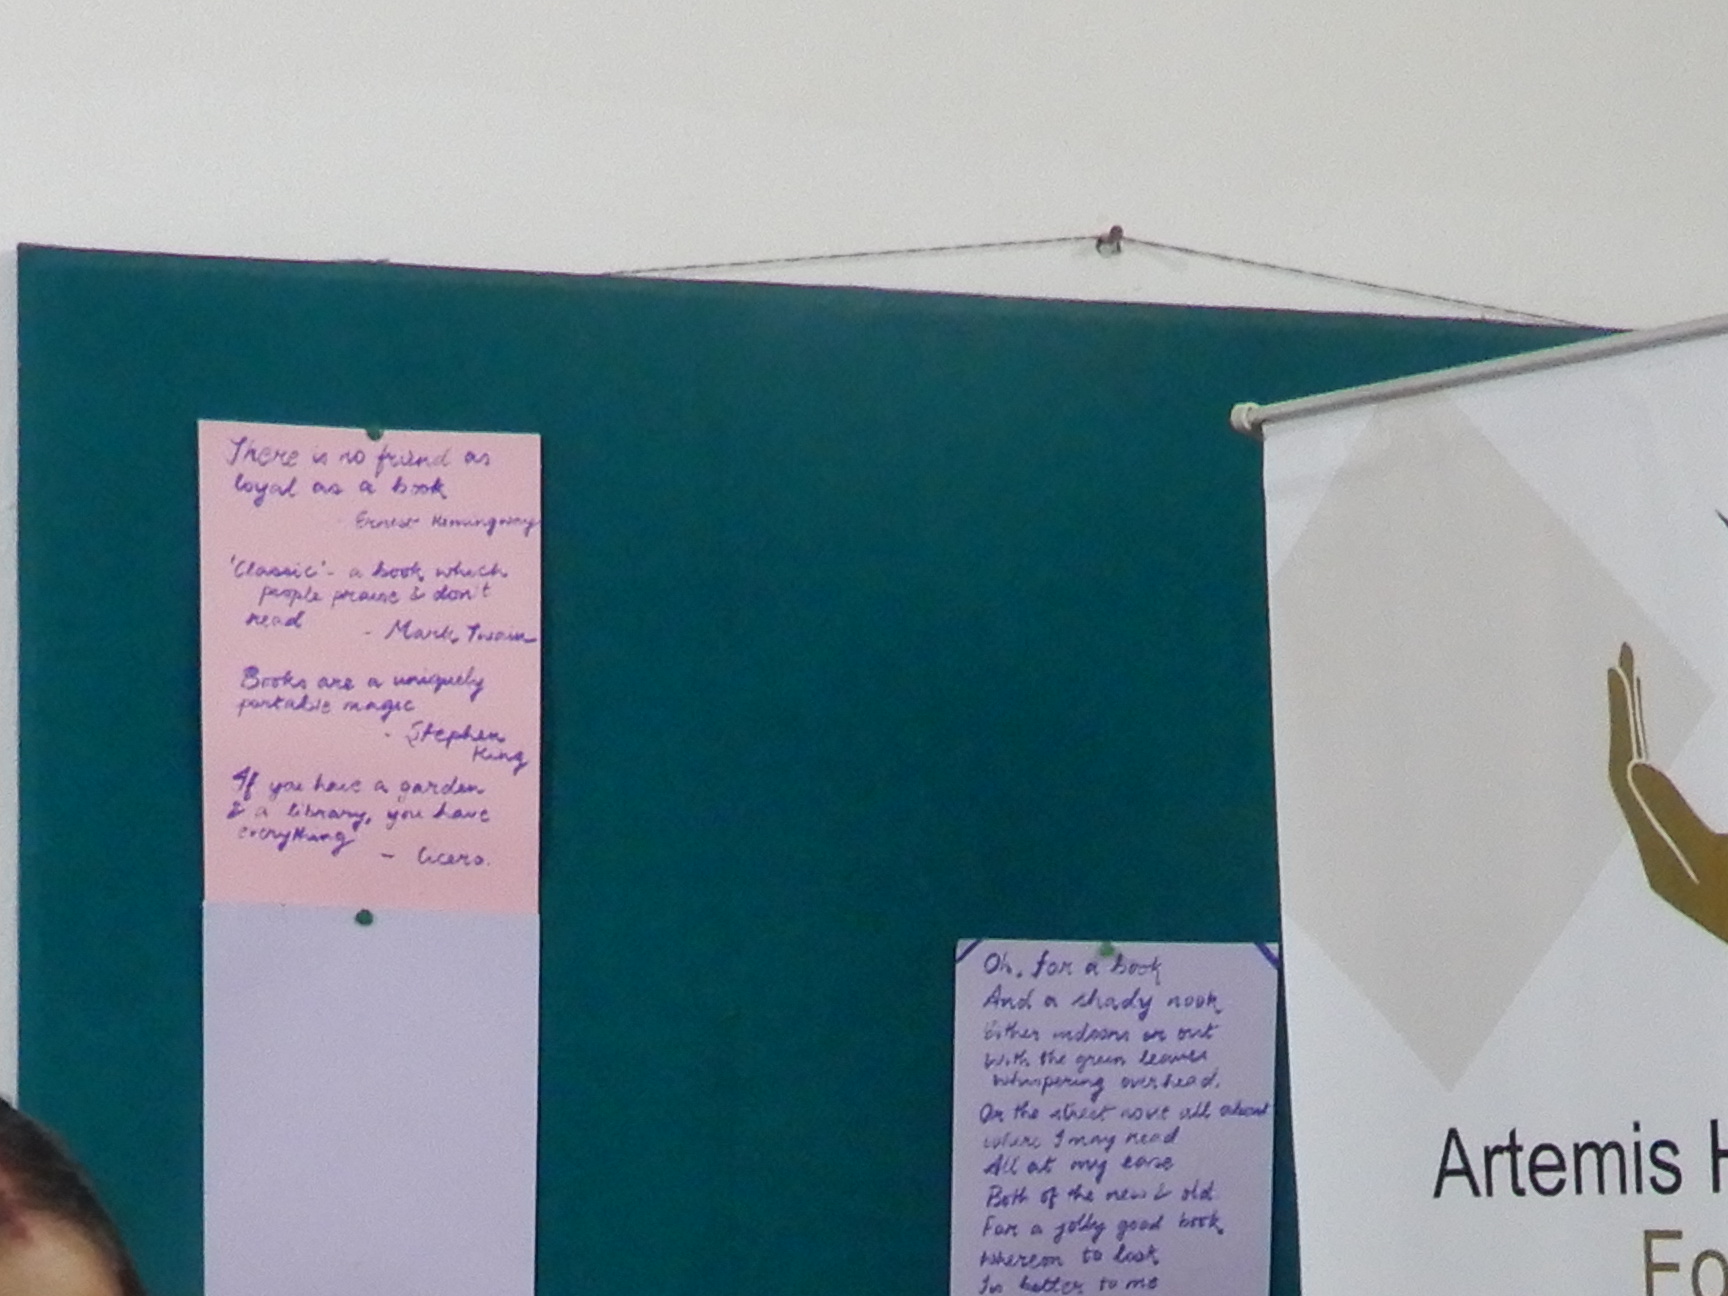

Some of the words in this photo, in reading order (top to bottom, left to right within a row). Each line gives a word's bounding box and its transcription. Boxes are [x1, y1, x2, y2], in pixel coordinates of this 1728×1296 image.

[226, 436, 298, 467] There
[313, 447, 327, 465] is
[339, 451, 366, 465] no
[377, 445, 450, 478] friend
[464, 452, 490, 466] as
[234, 473, 296, 507] loyal
[312, 481, 343, 495] as
[359, 480, 376, 494] a
[392, 477, 448, 499] book
[349, 568, 363, 579] a
[435, 564, 508, 579] which
[245, 611, 306, 628] read
[385, 620, 459, 644] Mark
[467, 623, 537, 643] Twain
[241, 665, 307, 689] Books
[317, 675, 354, 690] are
[368, 676, 383, 689] a
[393, 667, 484, 702] uniquely
[238, 695, 331, 716] portable
[342, 698, 415, 722] magic
[405, 720, 506, 748] Stephen
[473, 747, 528, 776] King
[233, 766, 259, 801] If
[270, 779, 303, 796] you
[314, 774, 361, 794] have
[374, 779, 389, 793] a
[400, 776, 484, 802] garden
[254, 808, 268, 819] a
[387, 809, 424, 829] you
[433, 803, 491, 822] have
[238, 826, 355, 856] everything
[1032, 950, 1073, 978] for
[1085, 961, 1099, 976] a
[1110, 954, 1162, 986] book
[983, 984, 1032, 1009] And
[1044, 995, 1058, 1008] a
[1071, 989, 1153, 1021] shady
[1177, 1024, 1220, 1041] out
[1040, 1050, 1066, 1066] the
[1075, 1054, 1126, 1073] green
[1139, 1050, 1208, 1066] leaves
[1014, 1103, 1040, 1122] the
[1180, 1103, 1211, 1121] all
[1068, 1134, 1116, 1155] may
[1126, 1127, 1180, 1145] read
[984, 1153, 1018, 1176] All
[1027, 1159, 1056, 1175] at
[1071, 1159, 1107, 1181] my
[1122, 1158, 1175, 1172] ease
[1433, 1120, 1683, 1199] Artemis
[986, 1184, 1029, 1208] Both
[1041, 1184, 1057, 1209] of
[1068, 1185, 1094, 1203] the
[1106, 1188, 1148, 1202] new
[1181, 1180, 1215, 1202] old
[983, 1215, 1019, 1238] For
[1030, 1224, 1044, 1235] a
[1054, 1213, 1107, 1244] jolly
[1117, 1216, 1164, 1242] good
[1083, 1248, 1103, 1265] to
[1113, 1245, 1160, 1266] look
[1019, 1277, 1084, 1296] better
[1100, 1279, 1116, 1292] to
[1126, 1278, 1159, 1291] me
